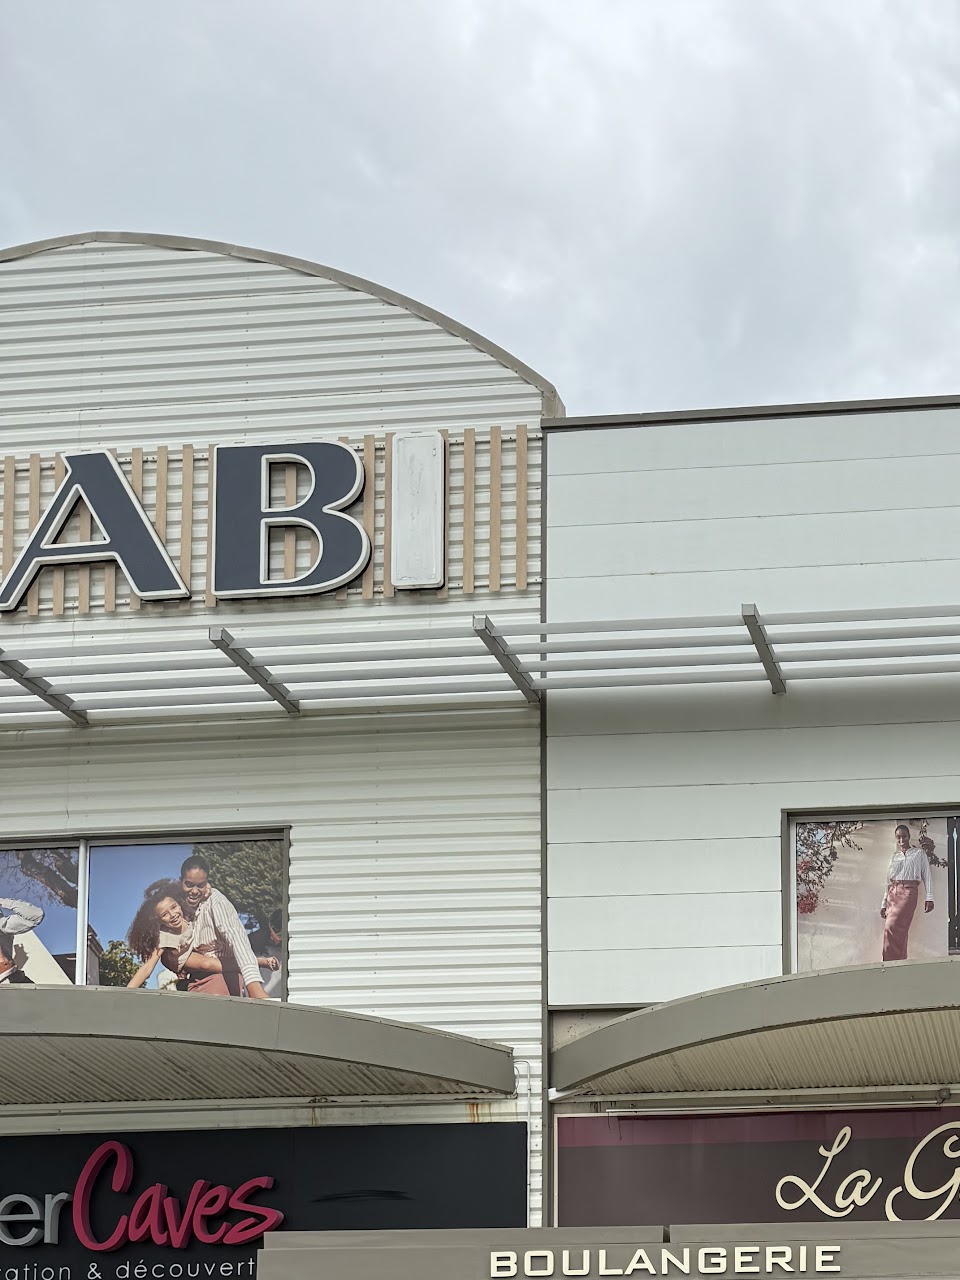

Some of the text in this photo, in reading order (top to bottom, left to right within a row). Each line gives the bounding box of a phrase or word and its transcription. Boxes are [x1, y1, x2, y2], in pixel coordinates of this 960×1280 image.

[775, 1125, 883, 1218] La
[87, 1262, 102, 1280] &
[489, 1245, 842, 1278] BOULANGERIE
